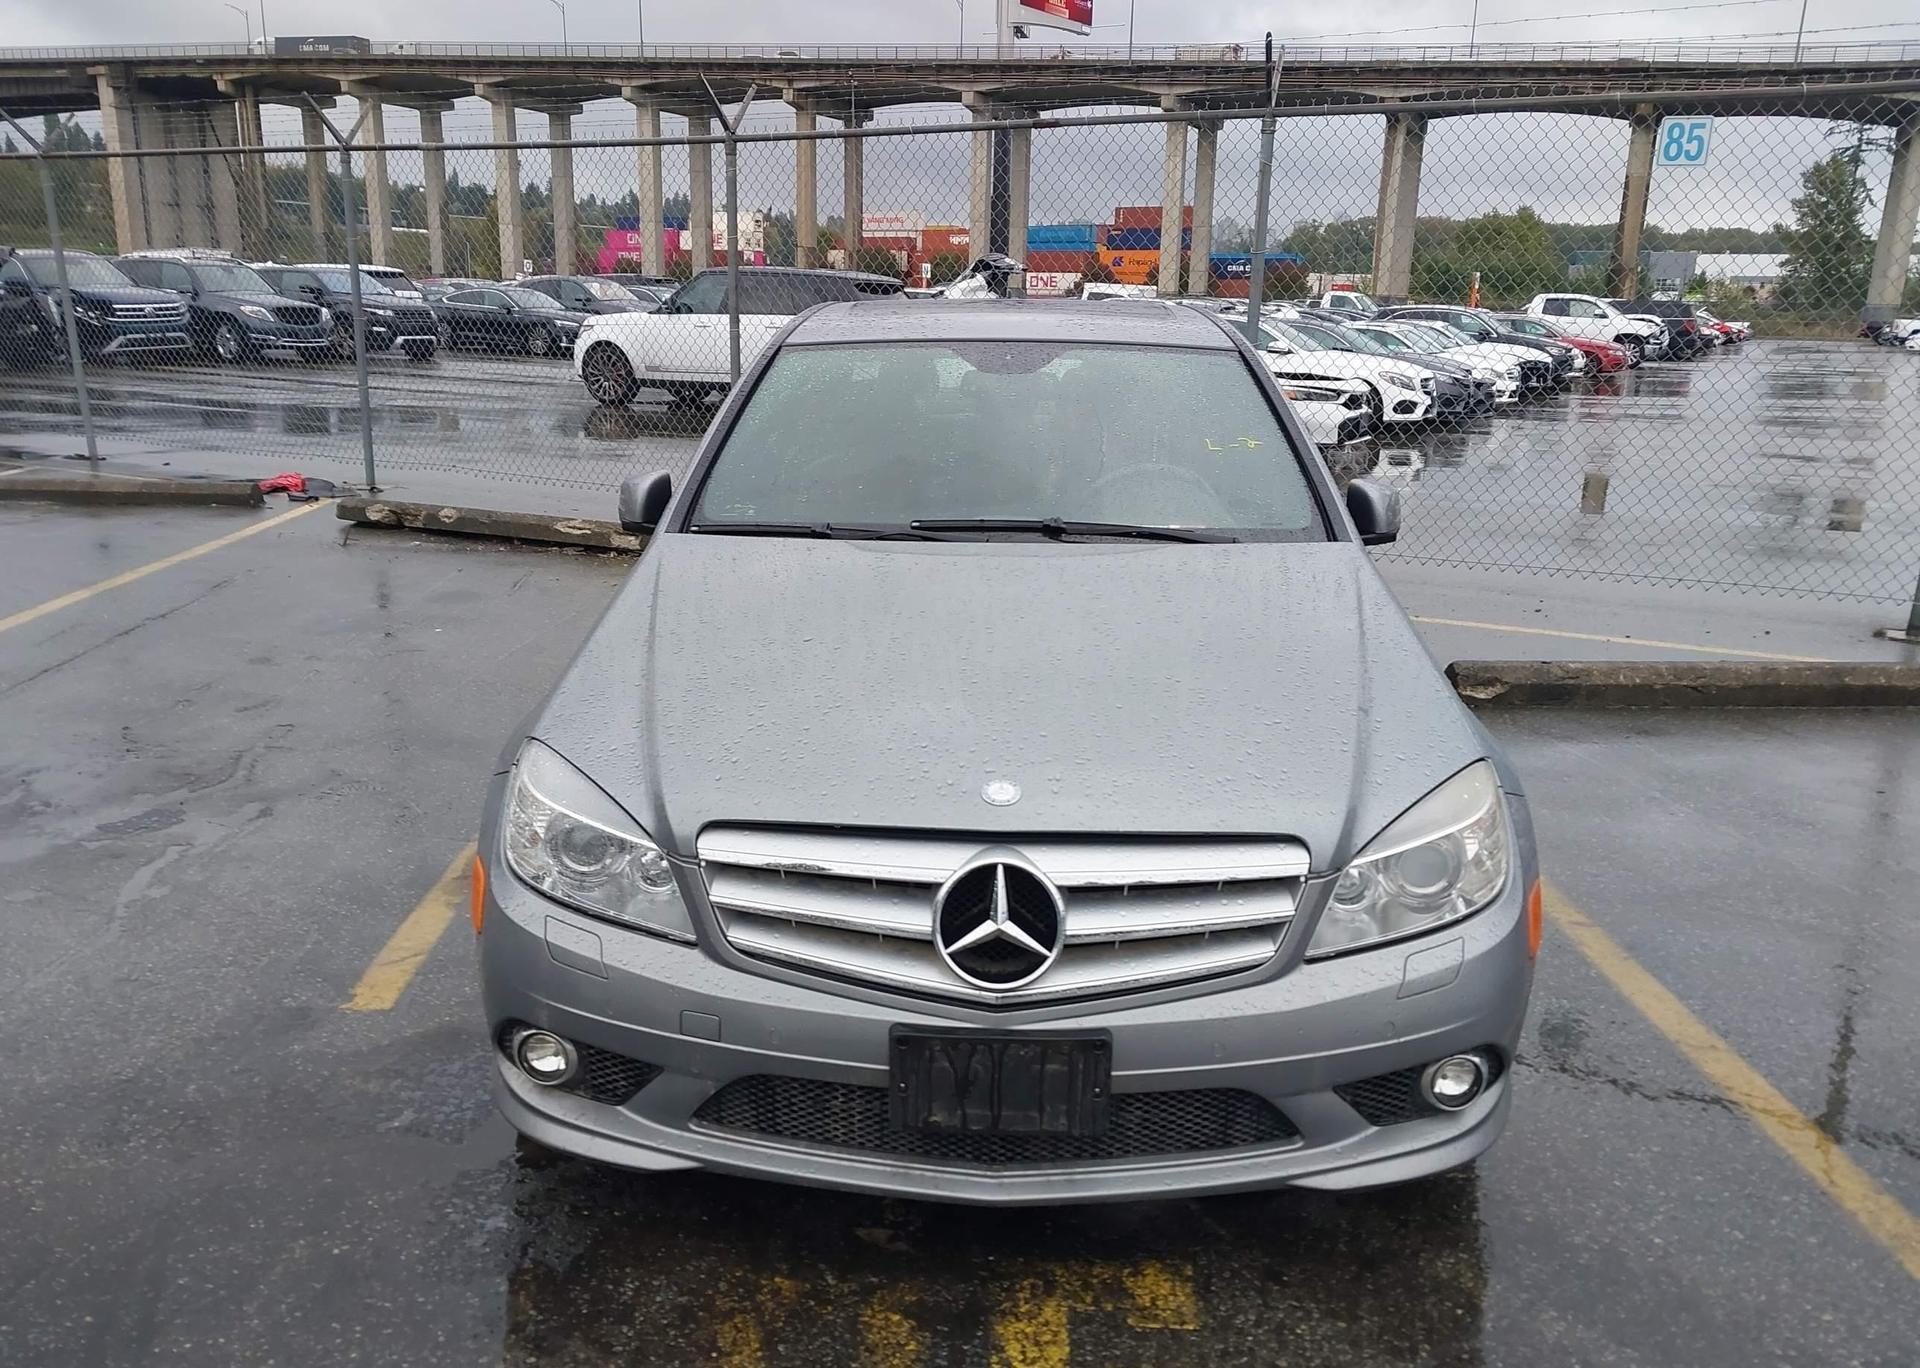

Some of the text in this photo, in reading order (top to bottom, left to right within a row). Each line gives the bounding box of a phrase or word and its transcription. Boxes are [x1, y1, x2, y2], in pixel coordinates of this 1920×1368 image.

[1664, 122, 1707, 161] 85
[627, 233, 640, 244] ON
[1030, 276, 1057, 287] ONE
